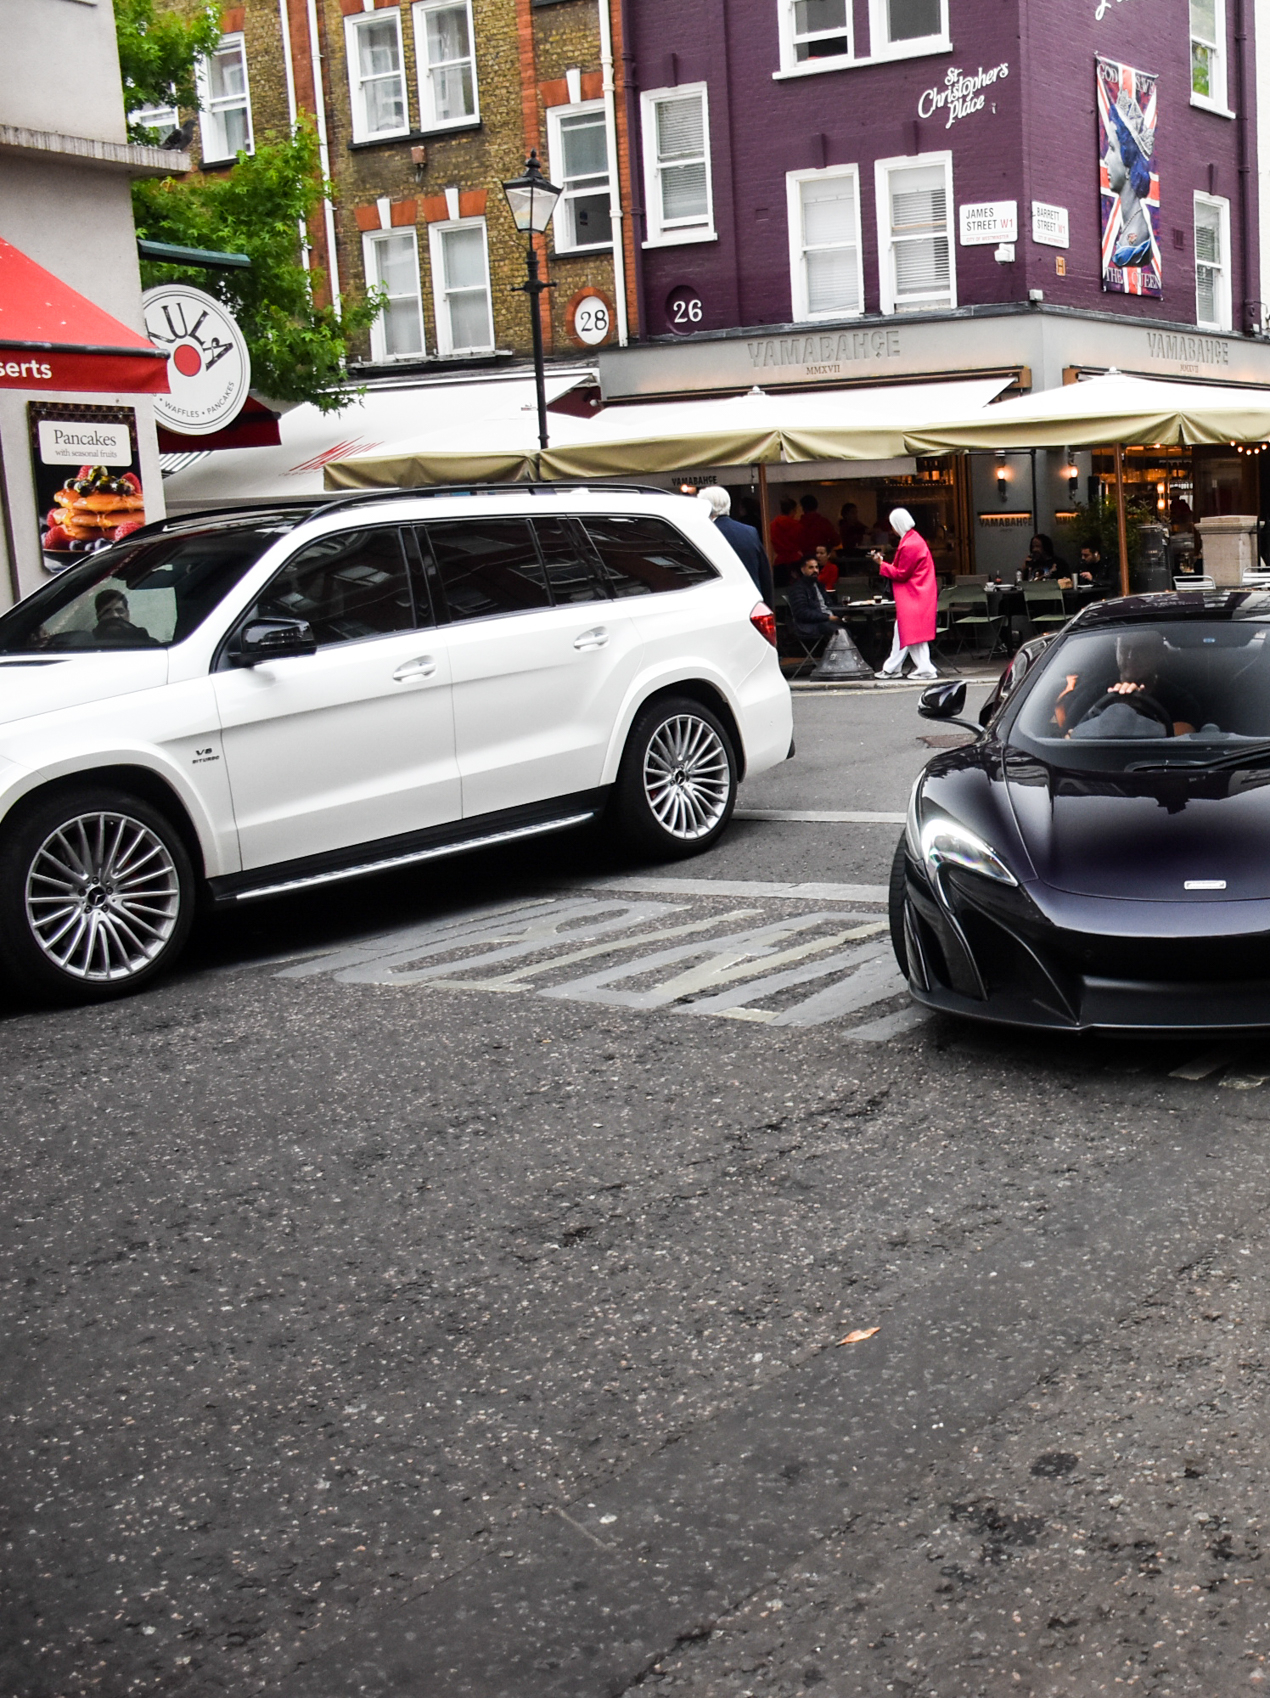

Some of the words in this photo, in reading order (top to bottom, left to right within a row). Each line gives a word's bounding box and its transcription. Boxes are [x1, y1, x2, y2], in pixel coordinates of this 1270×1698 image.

[1096, 63, 1118, 83] GOD
[945, 94, 985, 130] Place
[965, 207, 994, 220] JAMES
[1036, 206, 1060, 221] BARRETT
[966, 219, 997, 232] STREET
[1000, 218, 1013, 229] W1
[1036, 219, 1057, 233] STREET
[1104, 266, 1124, 285] THE
[1131, 271, 1161, 289] QUEEN
[673, 299, 703, 323] 26
[580, 309, 608, 332] 28
[806, 364, 841, 375] MMXVII
[164, 400, 200, 418] WAFFLES
[206, 381, 235, 414] PANCAKES
[53, 429, 117, 447] Pancakes
[55, 448, 71, 458] with
[71, 449, 99, 459] seasonal
[99, 450, 118, 459] fruits
